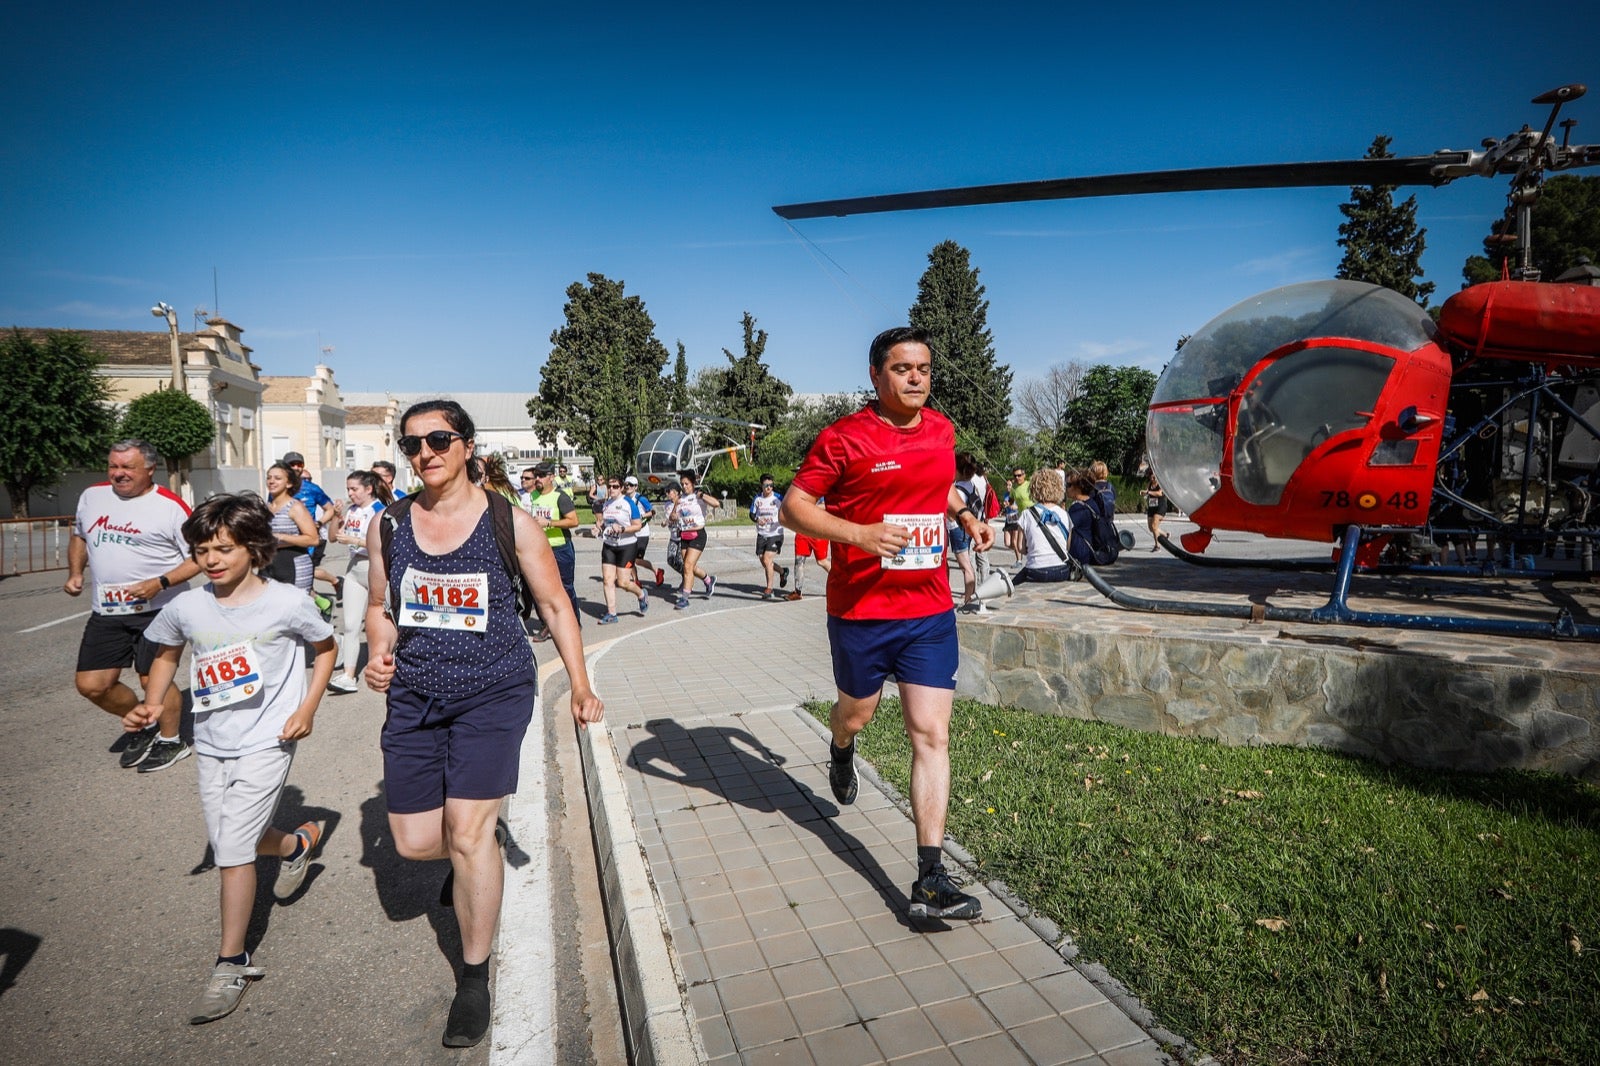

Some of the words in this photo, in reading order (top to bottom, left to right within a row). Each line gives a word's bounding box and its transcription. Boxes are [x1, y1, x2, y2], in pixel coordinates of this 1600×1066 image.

[1320, 490, 1350, 508] 78
[1386, 490, 1419, 510] 48
[93, 530, 141, 547] JEREZ
[419, 575, 445, 583] CARRERA
[105, 589, 137, 602] 112
[416, 584, 479, 608] 1182
[197, 656, 251, 688] 1183
